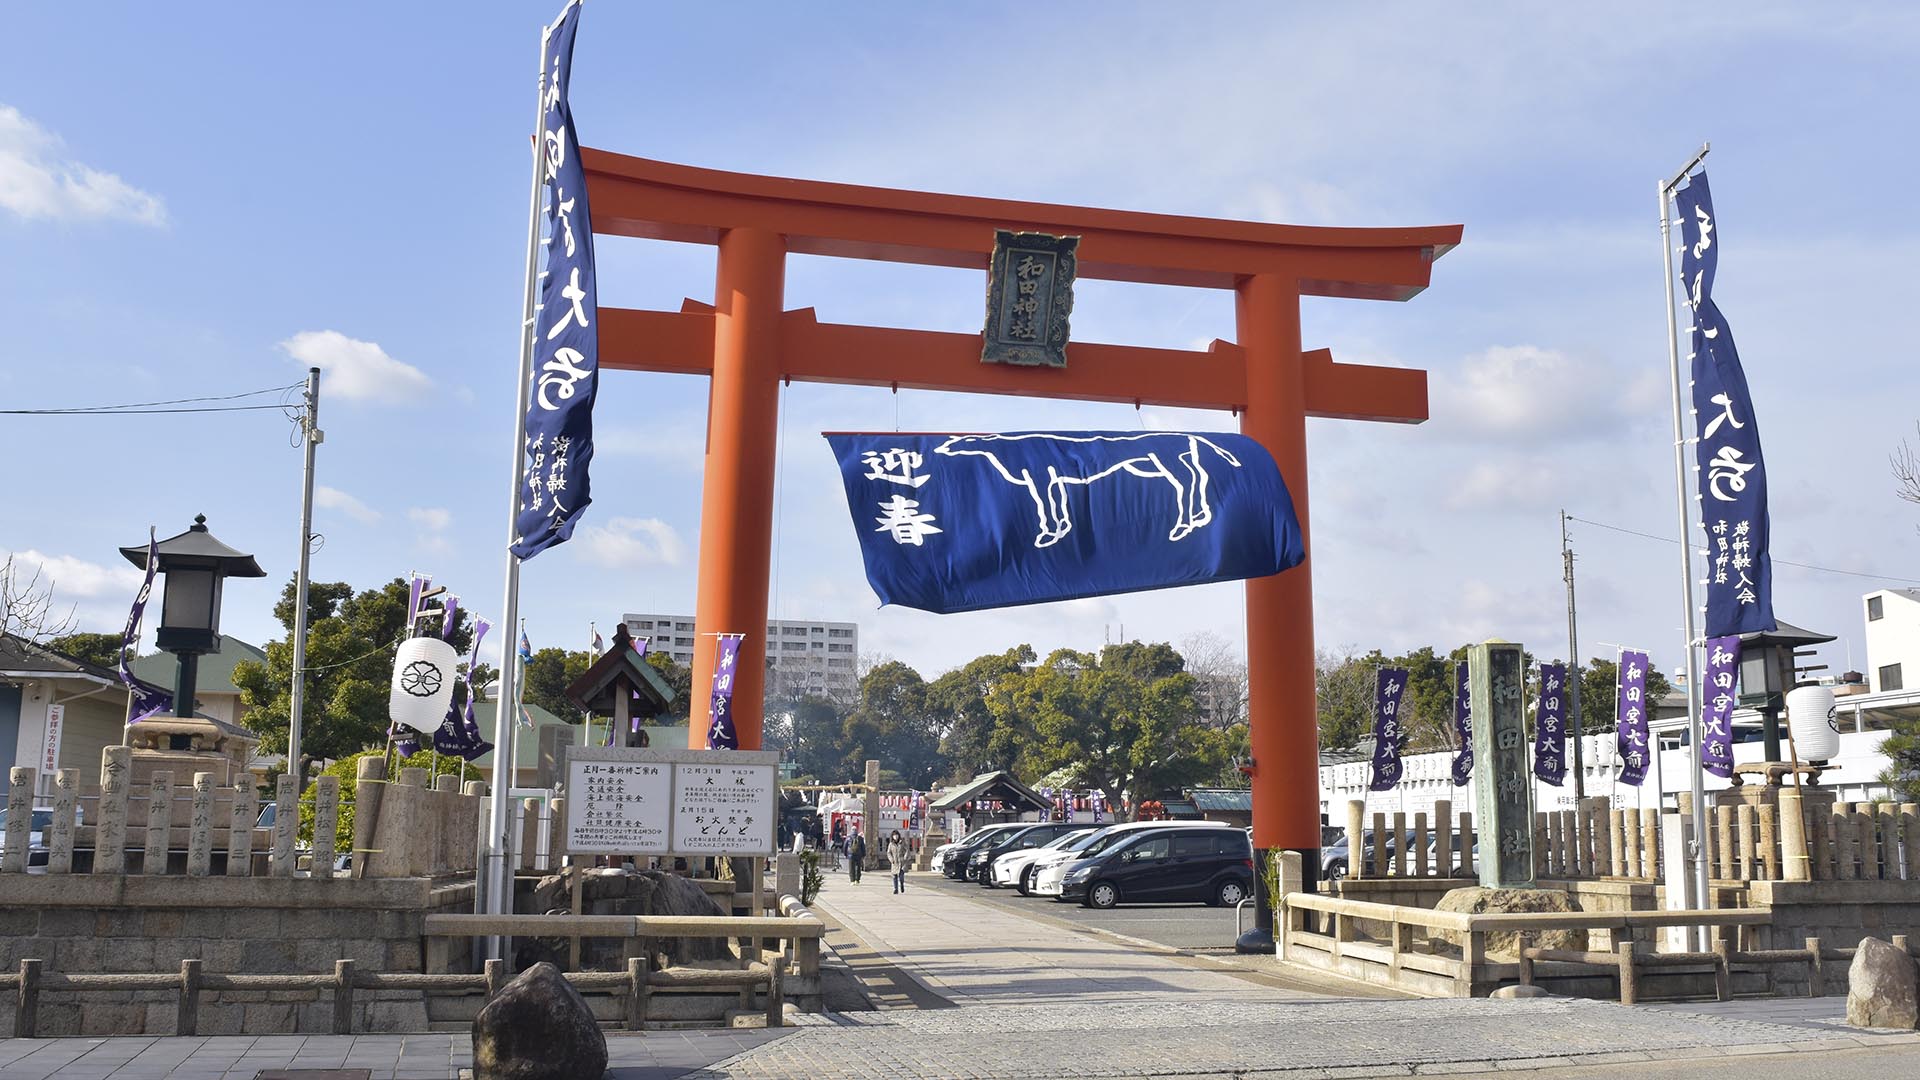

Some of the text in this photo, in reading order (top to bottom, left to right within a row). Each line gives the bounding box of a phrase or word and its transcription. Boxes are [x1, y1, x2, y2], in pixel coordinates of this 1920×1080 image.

[1010, 255, 1046, 340] 和田神社
[860, 447, 944, 547] 迎春
[1380, 678, 1400, 777] 和田宮大前
[1541, 674, 1560, 773] 和田宮大前
[1626, 661, 1644, 769] 和田宮大前
[1708, 645, 1733, 758] 和田宮大前
[1493, 675, 1530, 857] 和田神社
